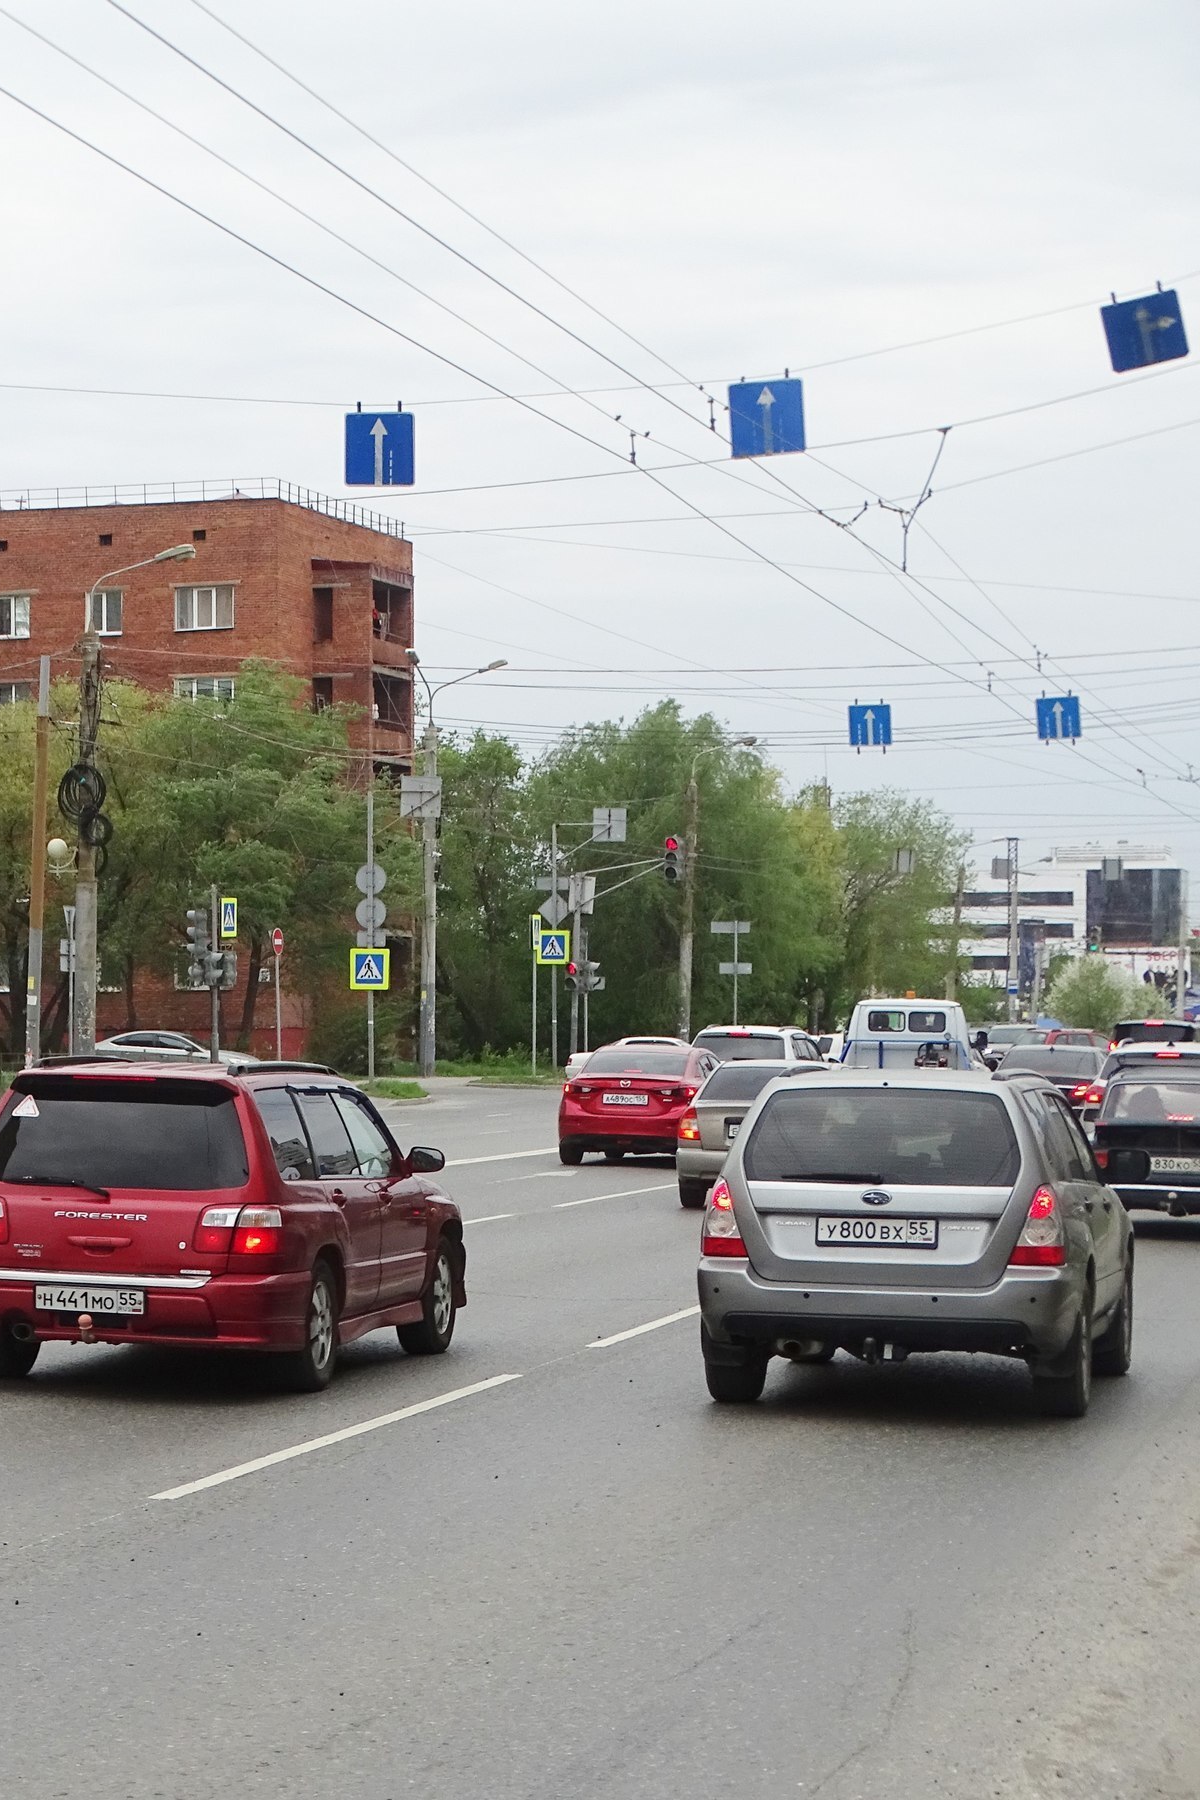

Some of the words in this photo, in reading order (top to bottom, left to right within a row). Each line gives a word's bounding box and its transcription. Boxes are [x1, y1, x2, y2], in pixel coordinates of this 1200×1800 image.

[1153, 1158, 1190, 1170] 830КО
[54, 1210, 148, 1221] FORESTER
[827, 1220, 904, 1240] У800ВХ
[909, 1221, 928, 1236] 55
[43, 1290, 115, 1310] Н441МО
[119, 1292, 137, 1306] 55
